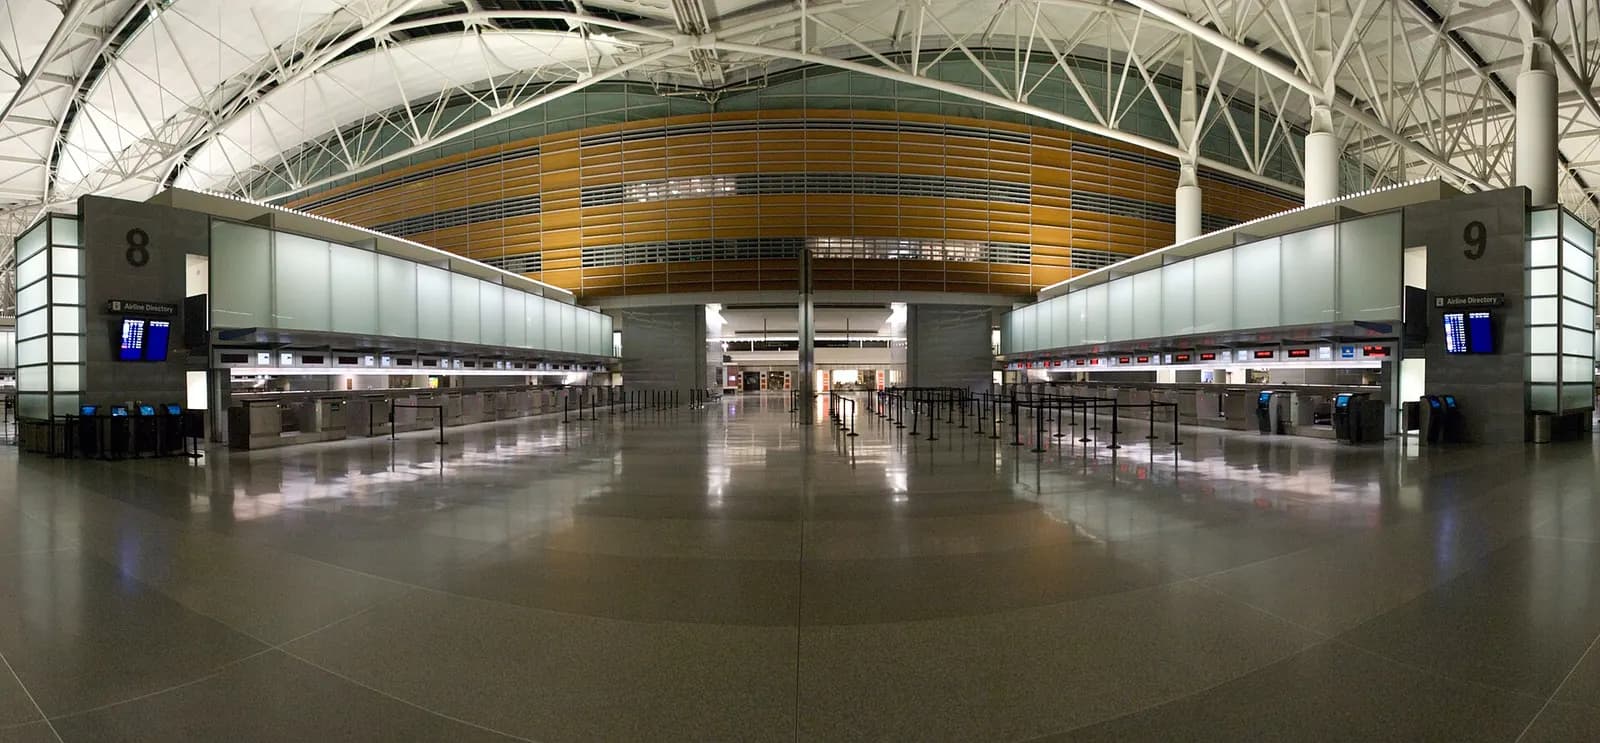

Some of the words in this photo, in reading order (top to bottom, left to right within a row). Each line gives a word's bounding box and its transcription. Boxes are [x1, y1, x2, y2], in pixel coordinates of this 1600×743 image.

[126, 228, 150, 267] 8
[1463, 220, 1487, 260] 9
[124, 303, 144, 311] Airline
[145, 304, 173, 313] Directory
[1447, 297, 1466, 305] Airline
[1468, 296, 1497, 304] Directory
